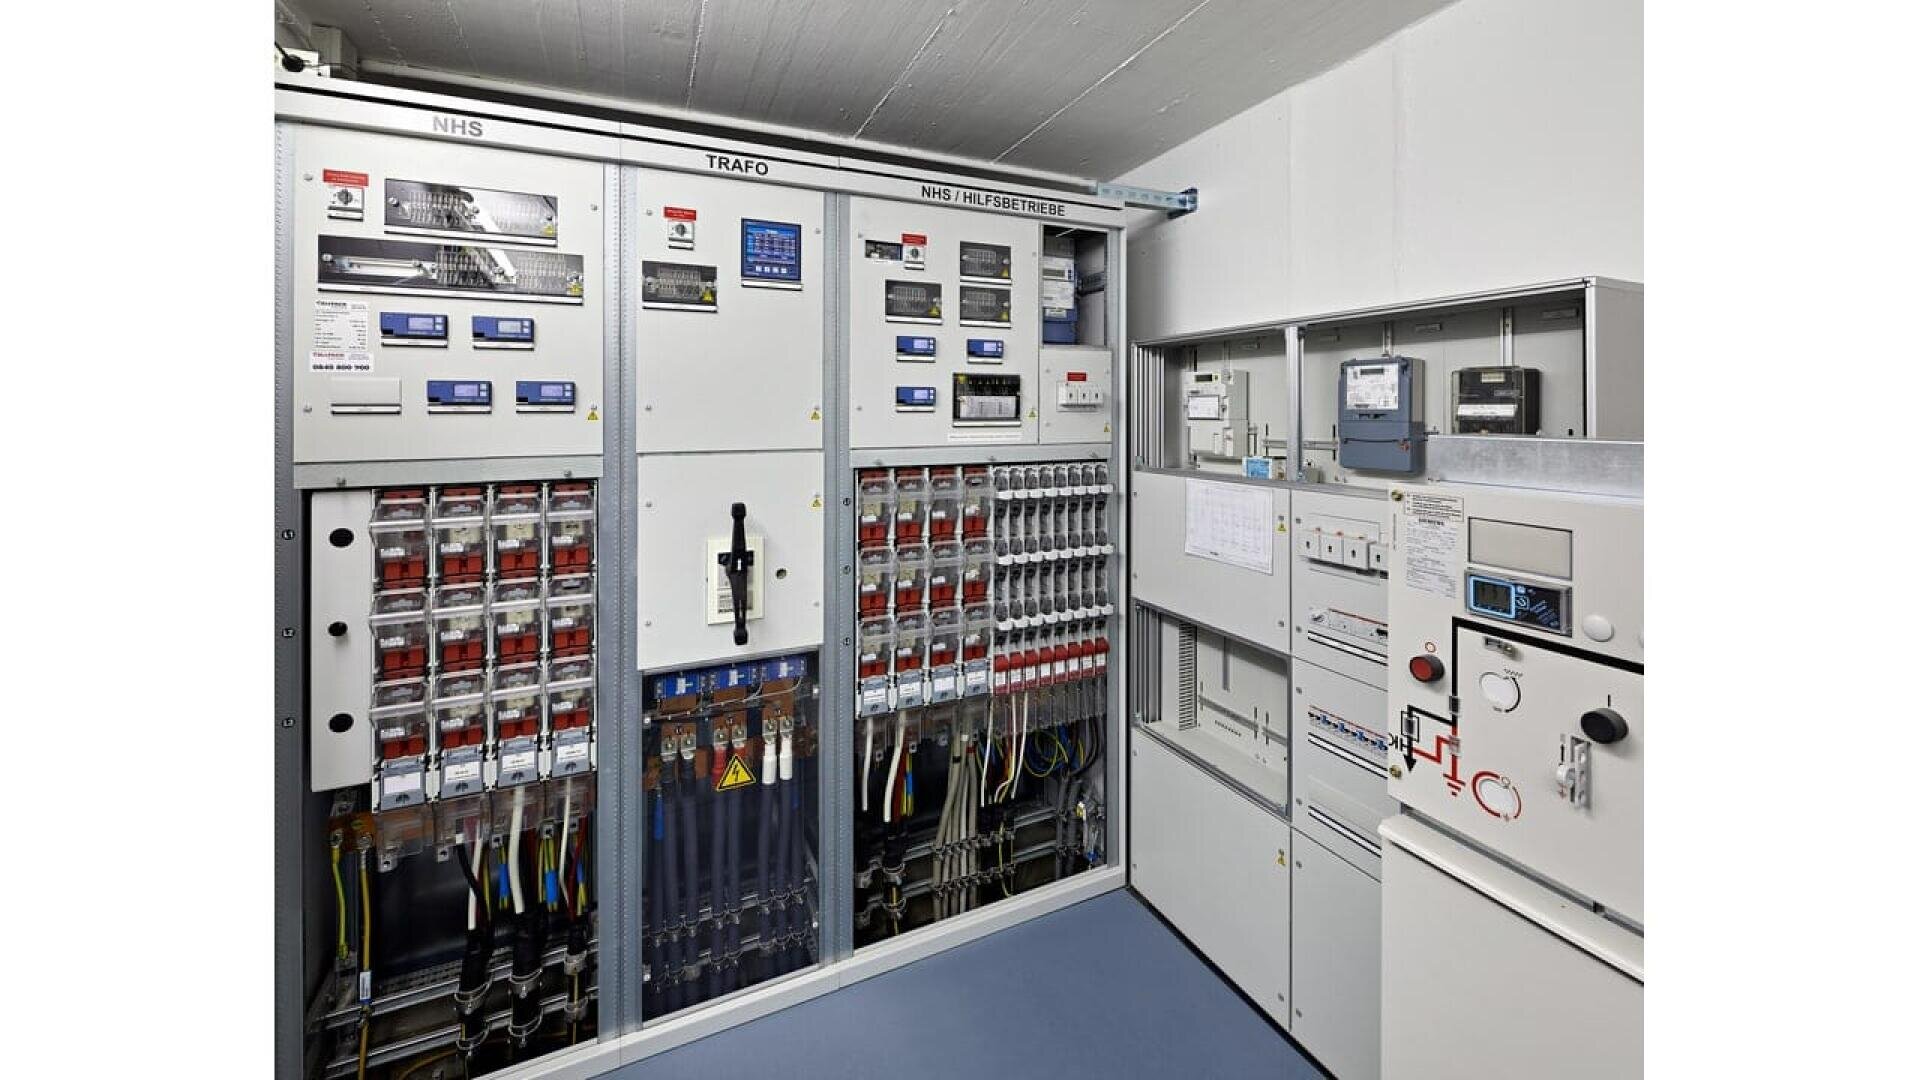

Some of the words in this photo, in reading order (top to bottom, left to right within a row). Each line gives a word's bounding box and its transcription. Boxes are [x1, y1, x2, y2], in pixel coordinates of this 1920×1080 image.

[433, 116, 482, 137] NHS
[705, 154, 769, 176] TRAFO
[921, 184, 951, 201] NHS
[963, 191, 1066, 217] HILFSBETRIEBE
